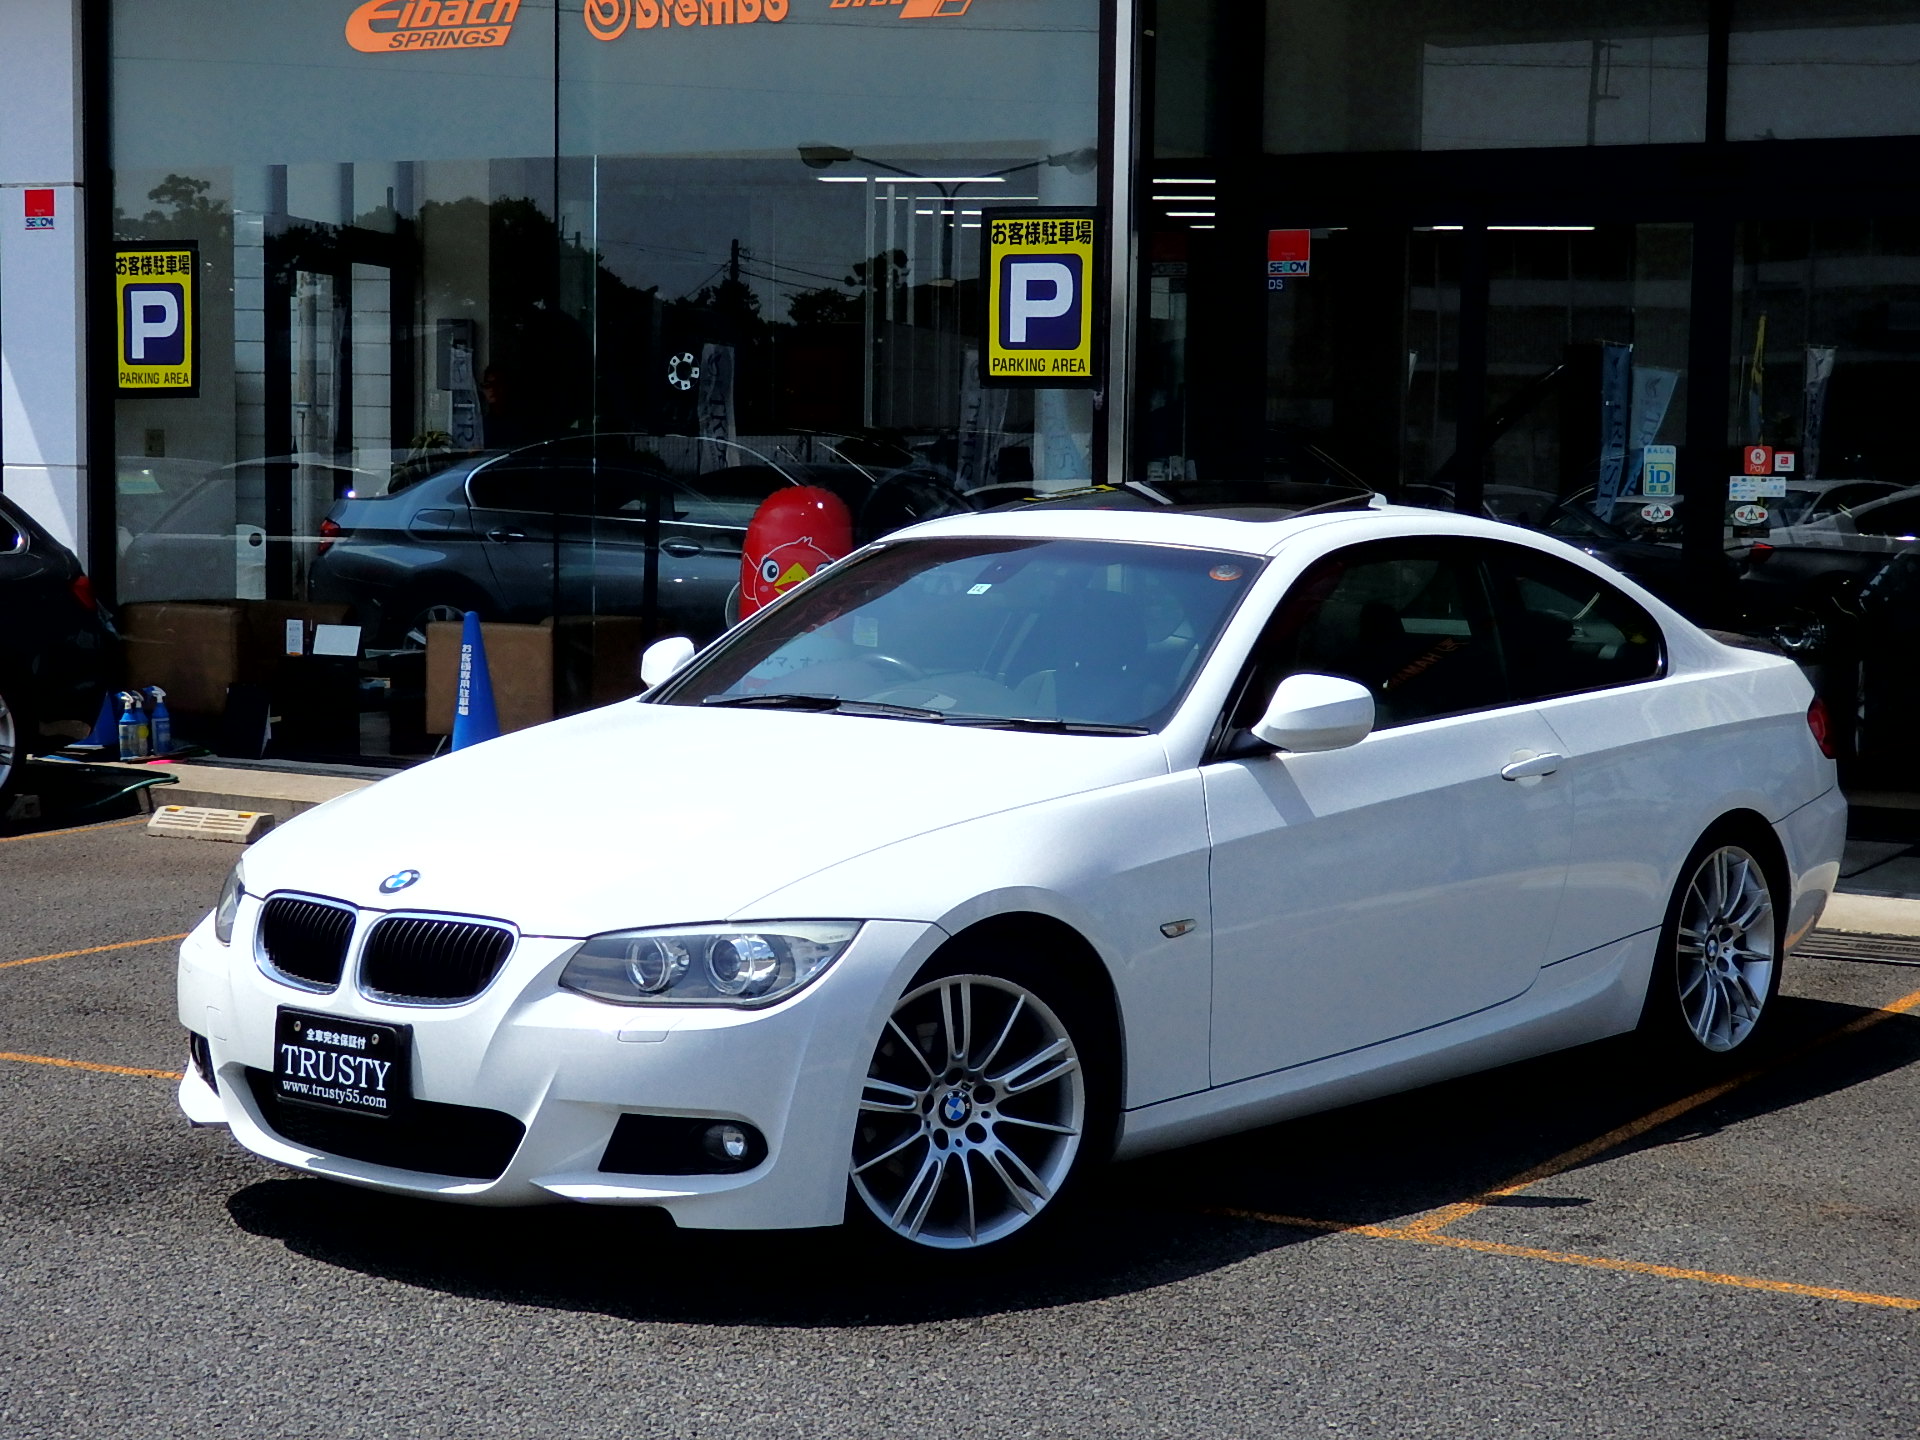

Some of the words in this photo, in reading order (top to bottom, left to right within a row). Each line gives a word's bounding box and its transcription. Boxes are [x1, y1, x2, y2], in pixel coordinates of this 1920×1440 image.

[388, 28, 498, 49] SPRINGS
[26, 217, 54, 227] SECOM
[991, 221, 1093, 245] お客様駐車場
[116, 254, 190, 276] お客様駐車場
[1269, 261, 1307, 273] SECOM
[1009, 262, 1074, 343] P
[130, 290, 179, 360] P
[992, 357, 1046, 372] PARKING
[1052, 358, 1086, 373] AREA
[120, 372, 160, 385] PARKING
[164, 372, 189, 385] AREA
[1750, 464, 1765, 473] Pay
[281, 1043, 391, 1091] TRUSTY
[282, 1080, 387, 1108] www.trusty55.com
